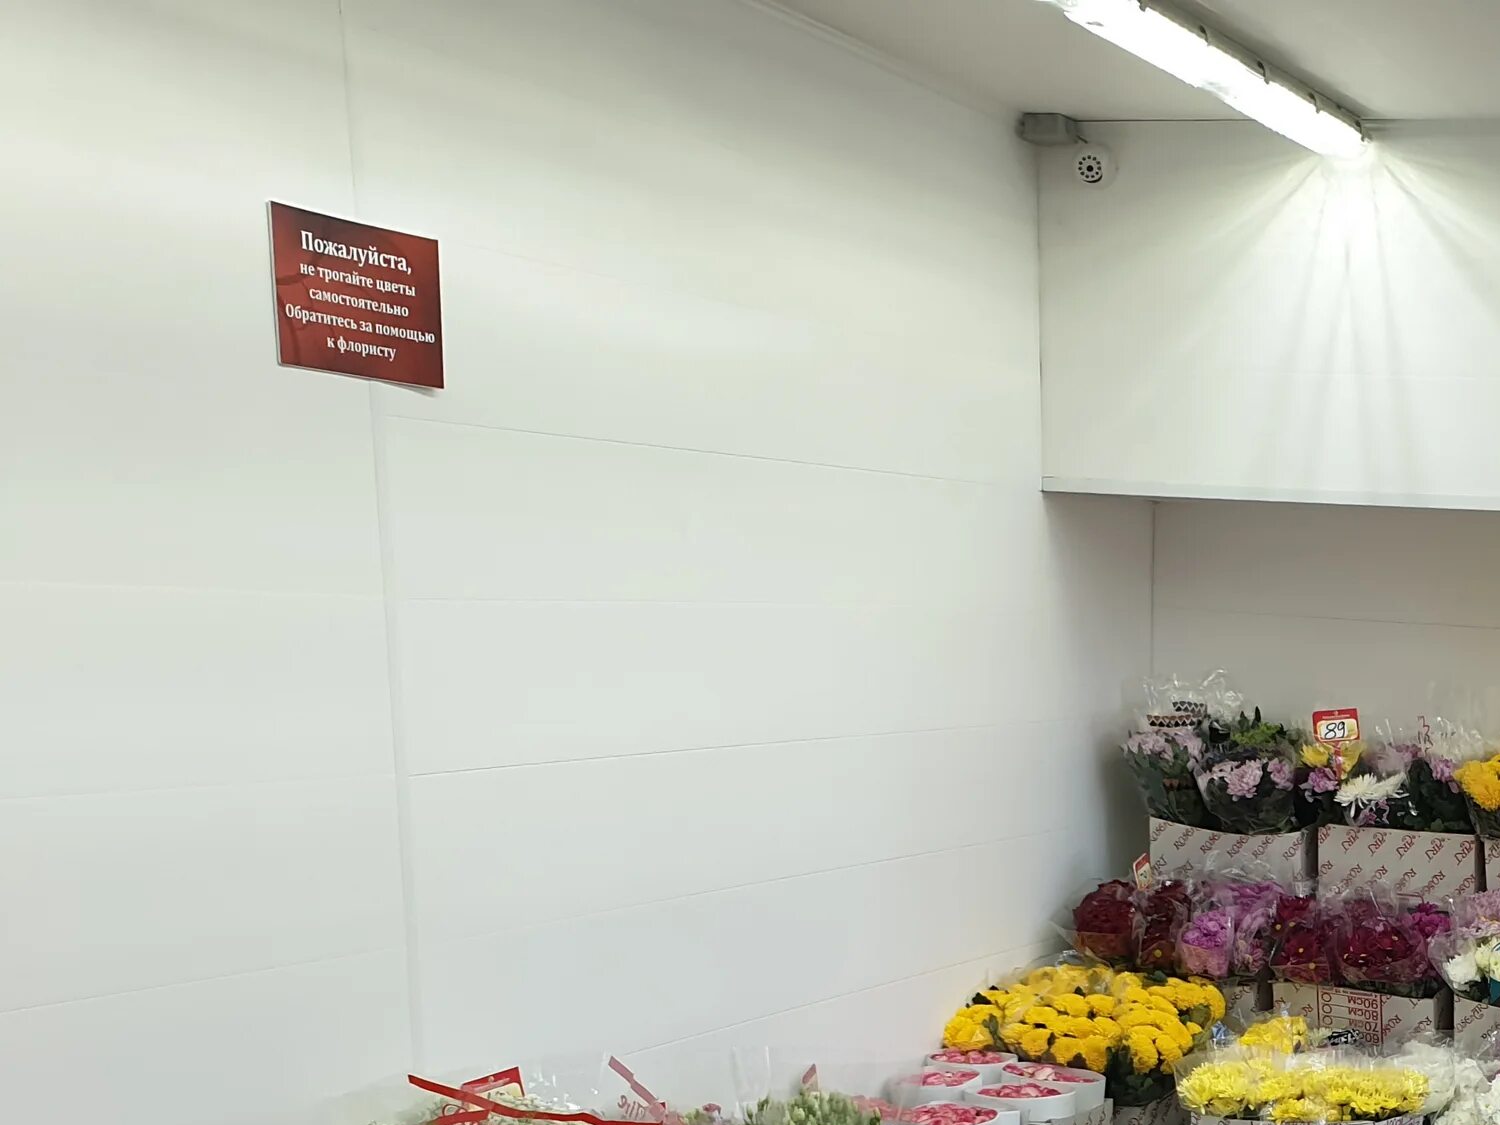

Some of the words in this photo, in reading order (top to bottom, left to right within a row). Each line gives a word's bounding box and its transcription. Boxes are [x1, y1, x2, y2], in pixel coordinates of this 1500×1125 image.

[300, 230, 412, 275] Пожалуйста,
[300, 263, 315, 276] не
[317, 267, 373, 288] трогайте
[376, 279, 416, 297] цветы
[309, 288, 409, 317] самостоятельно
[285, 304, 357, 330] Обратитесь
[359, 321, 372, 332] за
[376, 323, 435, 343] помощью
[327, 336, 335, 348] к
[337, 336, 396, 362] флористу
[1325, 721, 1345, 740] 89
